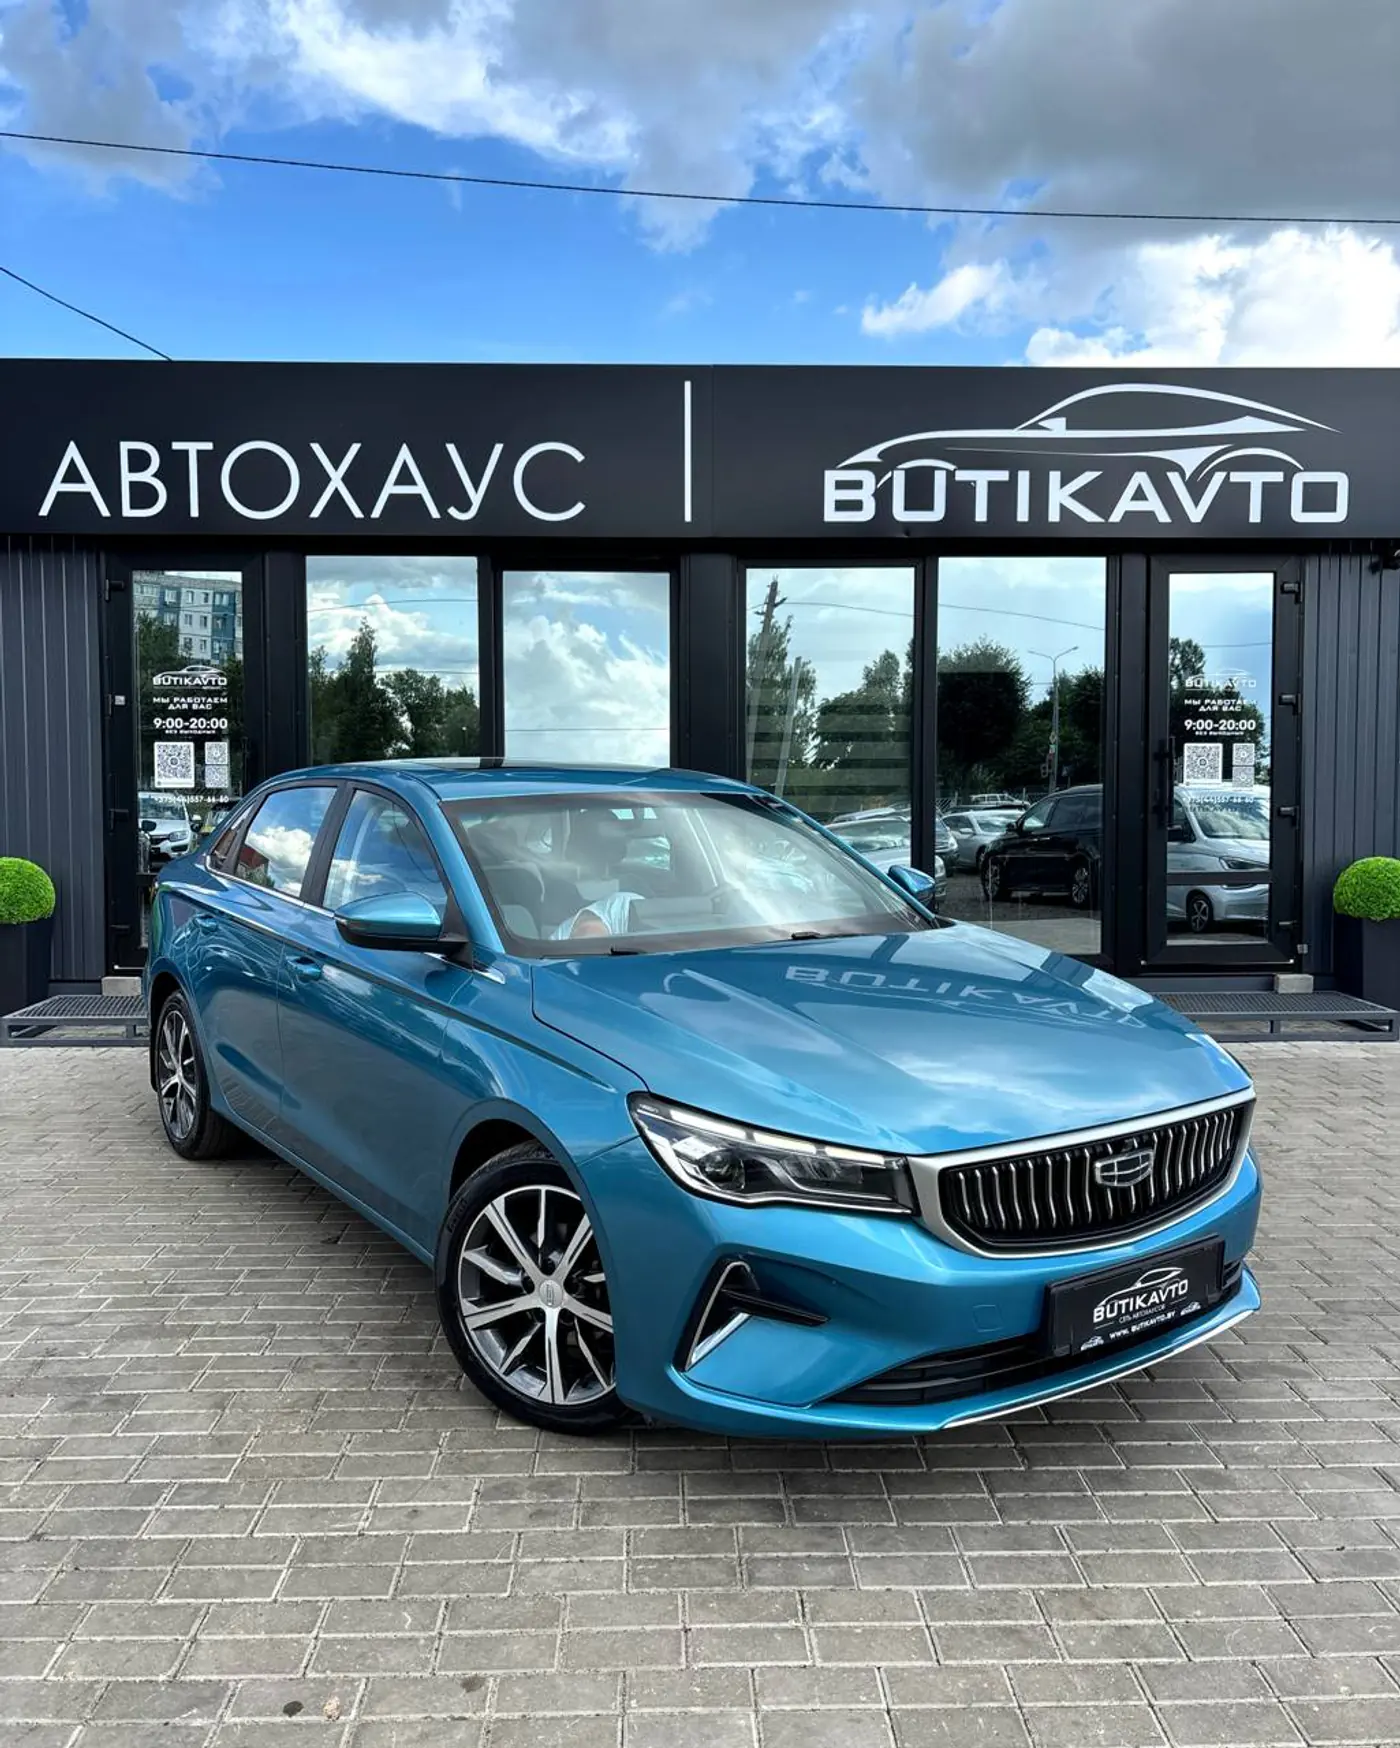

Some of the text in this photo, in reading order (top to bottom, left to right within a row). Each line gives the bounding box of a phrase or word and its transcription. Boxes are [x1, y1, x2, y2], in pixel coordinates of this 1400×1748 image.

[38, 440, 586, 522] АВТОХАУС
[823, 469, 1349, 524] BUTIKAVTO
[152, 676, 228, 686] BUTIKAVTO
[153, 696, 228, 704] МЫ РАБОТАЕМ
[167, 703, 213, 711] ДЛЯ ВАС
[153, 717, 229, 730] 9:00-20:00
[1184, 719, 1257, 731] 9:00-20:00
[1093, 1279, 1189, 1324] BUTIKAVTO
